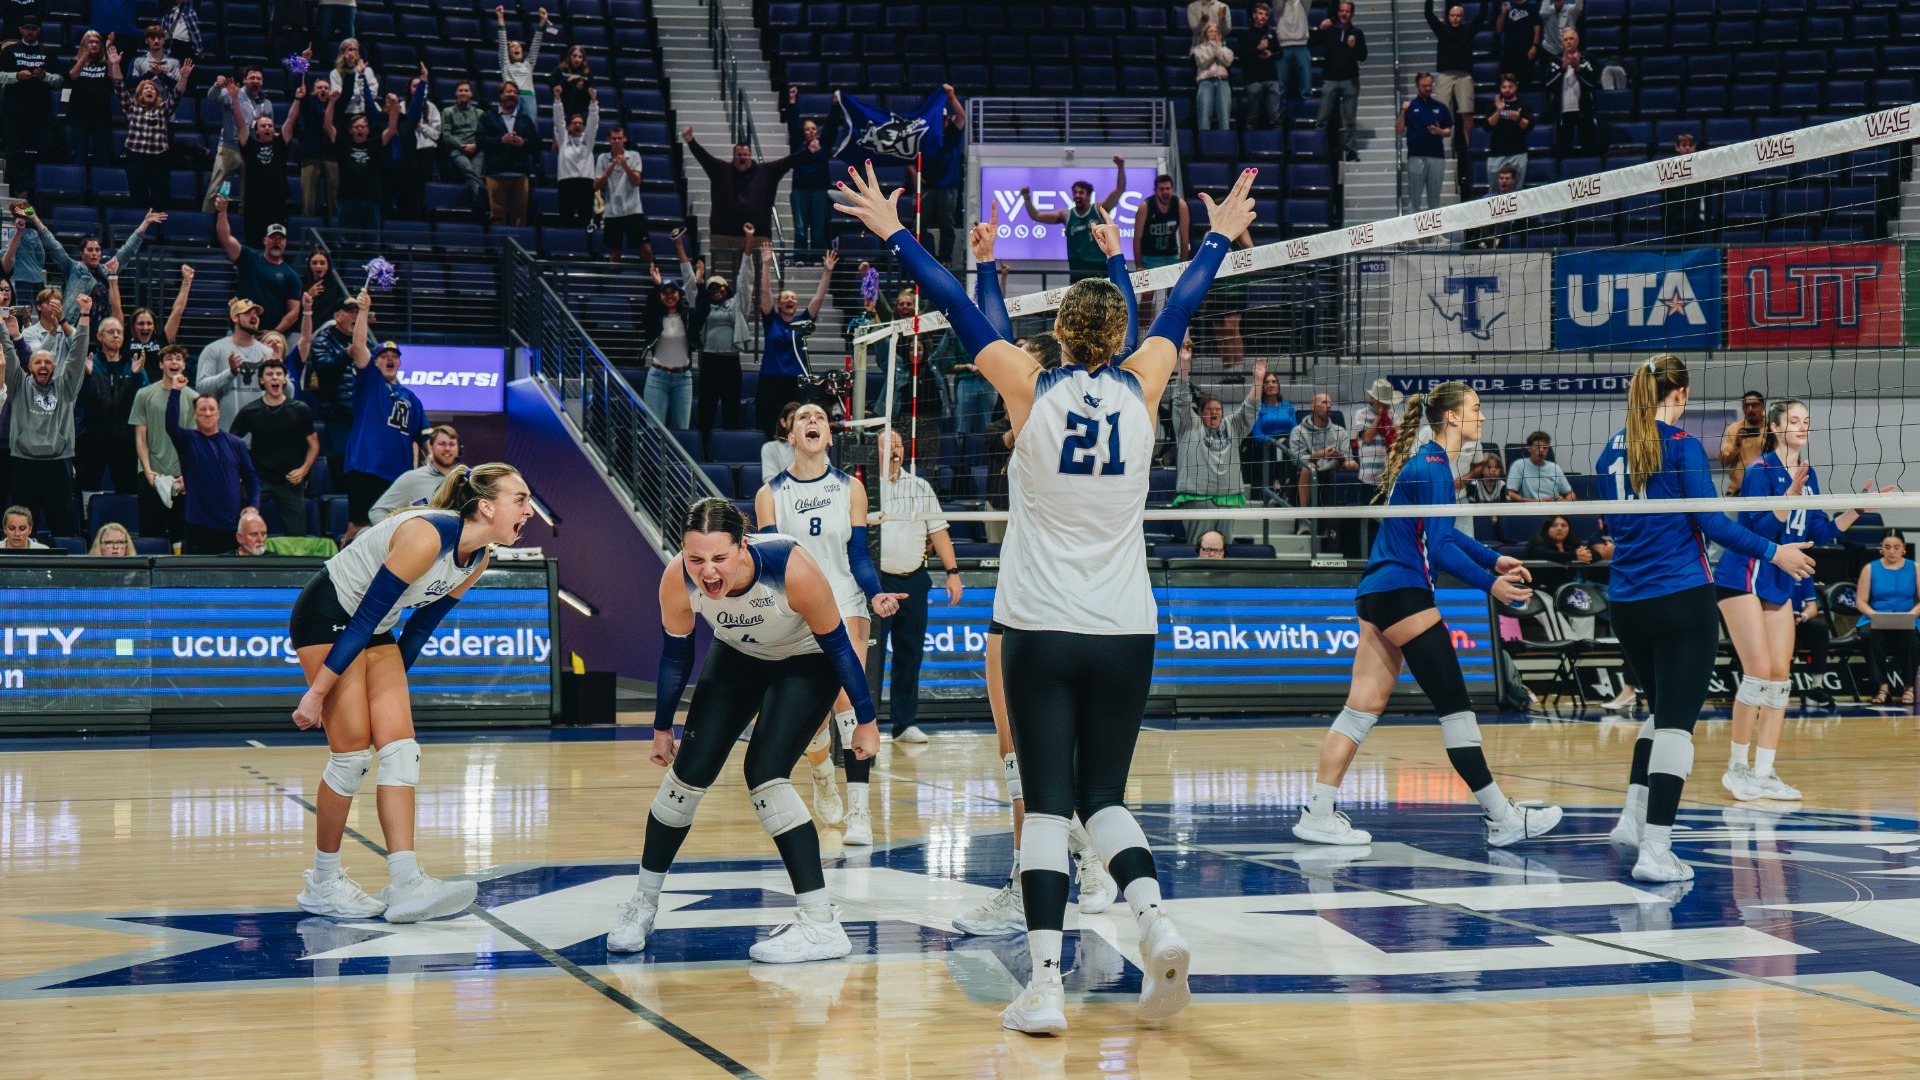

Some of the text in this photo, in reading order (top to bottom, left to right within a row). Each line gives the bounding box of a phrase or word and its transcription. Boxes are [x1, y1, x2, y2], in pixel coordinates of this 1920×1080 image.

[14, 52, 47, 60] WILDCAT
[1864, 107, 1912, 138] WAC
[1754, 133, 1796, 161] WAC
[1656, 156, 1693, 181] WAC
[1568, 176, 1601, 200] WAC
[1487, 195, 1518, 217] WAC
[1414, 211, 1442, 232] WAC
[1348, 223, 1374, 245] WAC
[1230, 250, 1253, 269] WAC
[1287, 239, 1310, 258] WAC
[1567, 271, 1707, 327] UTA
[396, 370, 499, 387] LDCATS!
[1057, 409, 1126, 477] 21
[795, 496, 832, 513] Abilene
[809, 516, 822, 537] 8
[749, 595, 775, 608] WAC
[716, 611, 765, 627] Abilene
[420, 628, 552, 663] ederally
[1172, 624, 1250, 651] Bank
[1253, 624, 1319, 649] with
[172, 634, 301, 664] ucu.org
